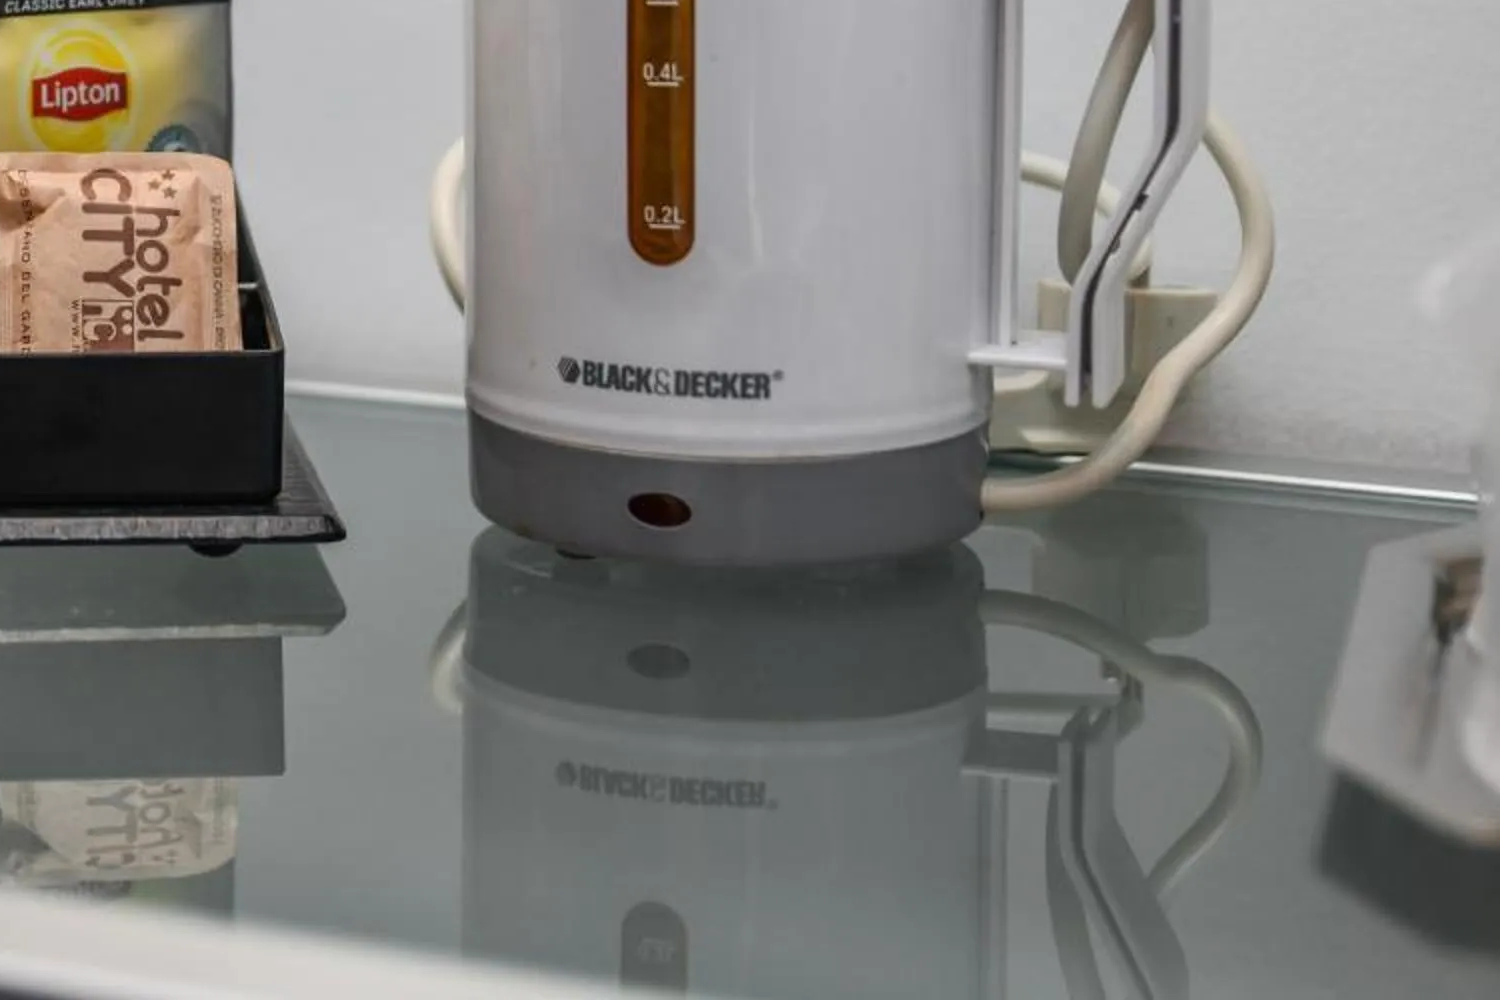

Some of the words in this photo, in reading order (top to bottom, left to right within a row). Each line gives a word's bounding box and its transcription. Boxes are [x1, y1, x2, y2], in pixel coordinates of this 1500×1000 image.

[643, 62, 685, 82] 0.4L
[40, 80, 121, 114] Lipton
[644, 205, 686, 224] 0.2L
[80, 167, 136, 299] CITY
[20, 270, 32, 302] DEL
[134, 206, 185, 342] hotel
